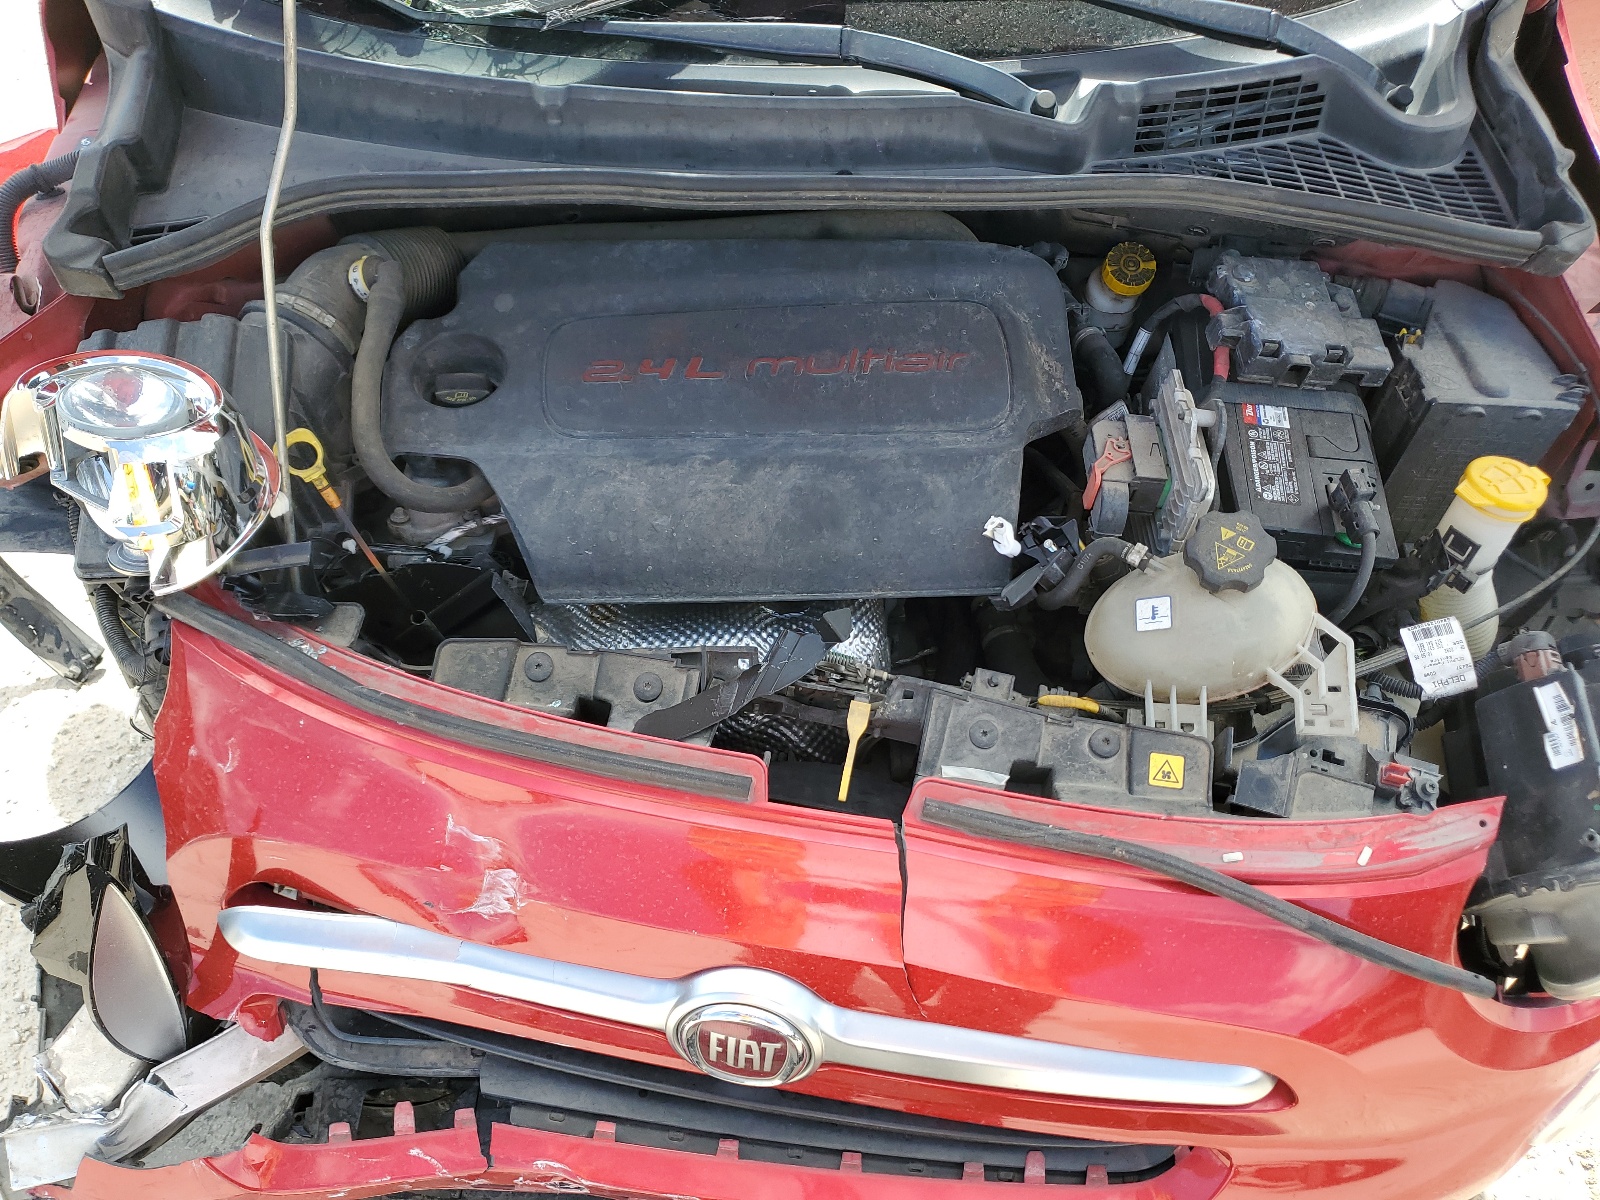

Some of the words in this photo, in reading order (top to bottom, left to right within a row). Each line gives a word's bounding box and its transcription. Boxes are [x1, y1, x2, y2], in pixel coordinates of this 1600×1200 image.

[582, 356, 723, 384] 2.4L
[745, 347, 969, 378] multiair
[1432, 674, 1466, 688] DELPHI
[709, 1031, 782, 1072] FIAT
